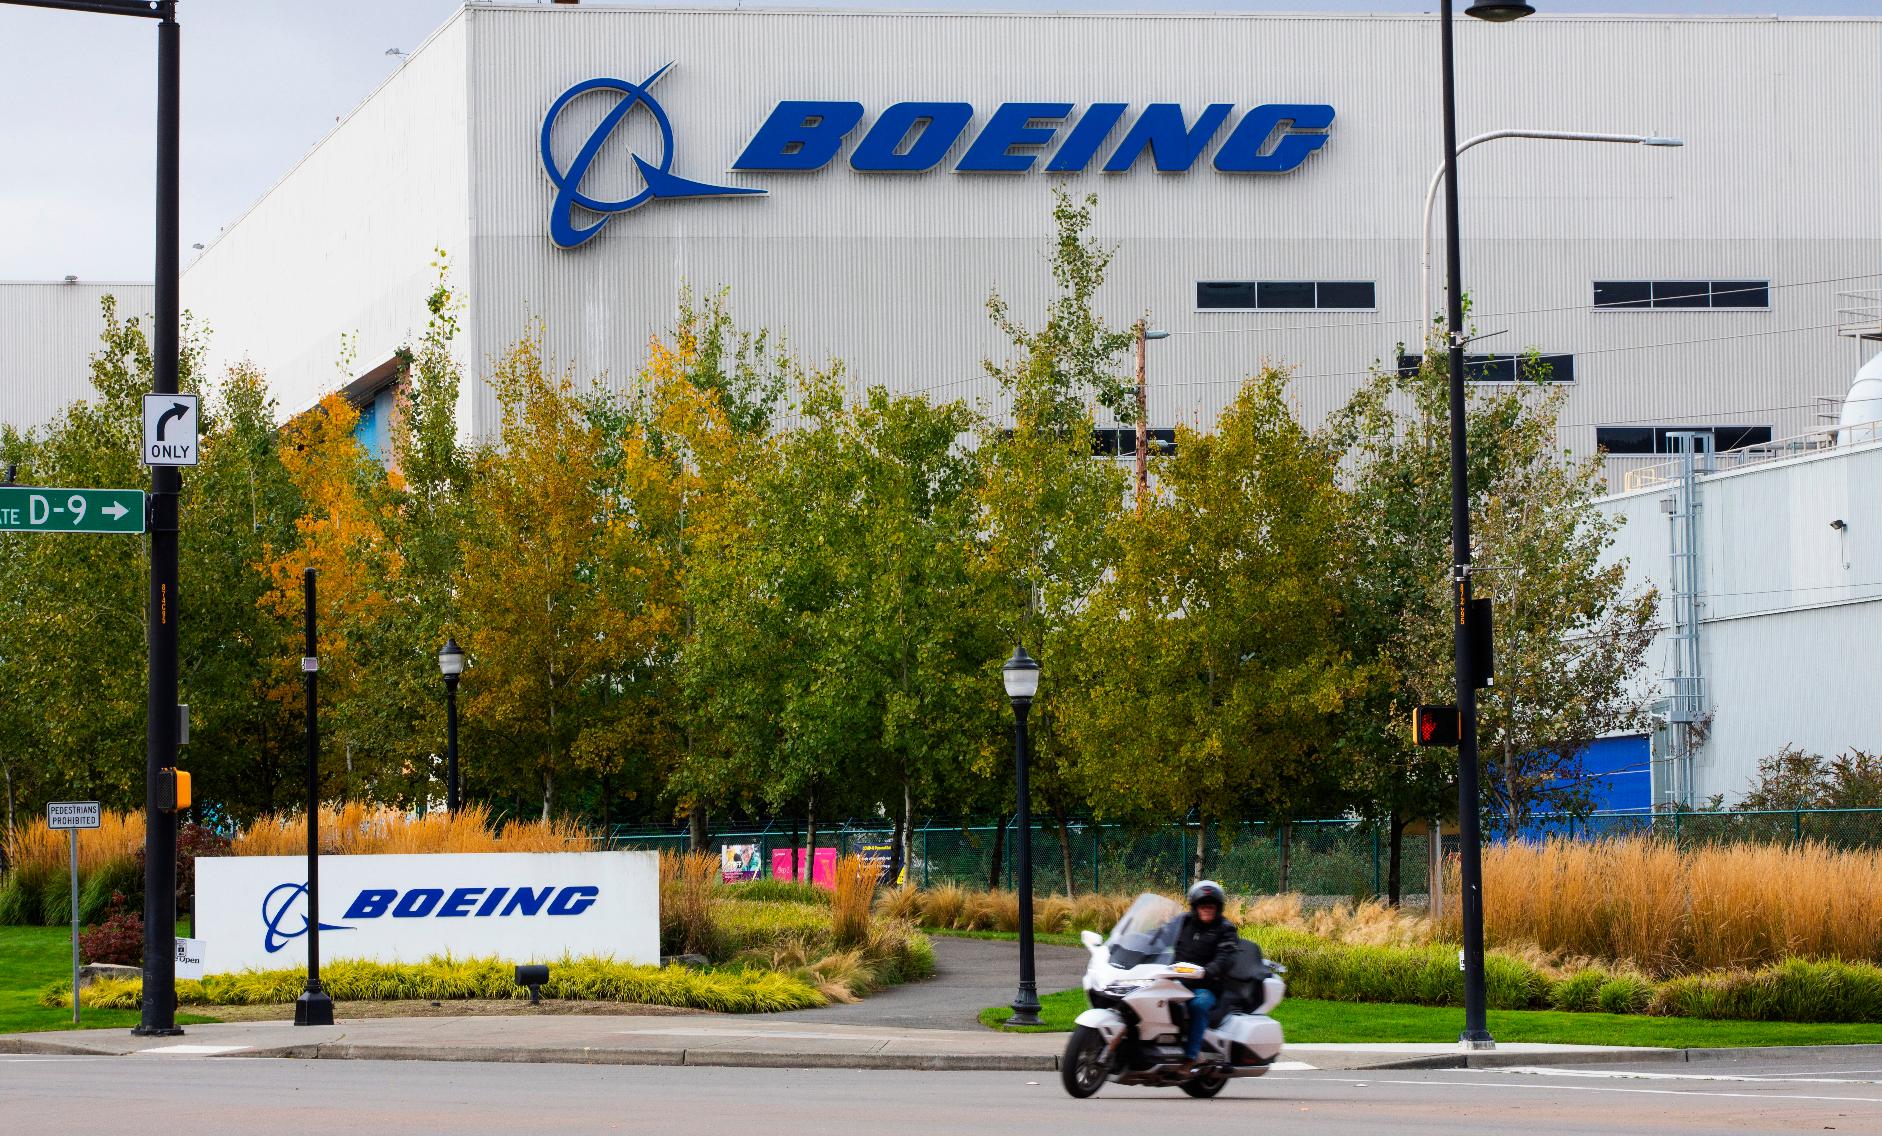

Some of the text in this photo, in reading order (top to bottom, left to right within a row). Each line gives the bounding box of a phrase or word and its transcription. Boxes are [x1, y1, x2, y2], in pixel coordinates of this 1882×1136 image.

[728, 100, 1335, 173] BOEING
[151, 444, 190, 459] ONLY
[29, 494, 87, 526] D-9
[50, 806, 97, 815] PEDESTRIANS
[52, 816, 96, 825] PROHIBITED
[342, 886, 599, 919] BOEING
[180, 956, 200, 964] Open
